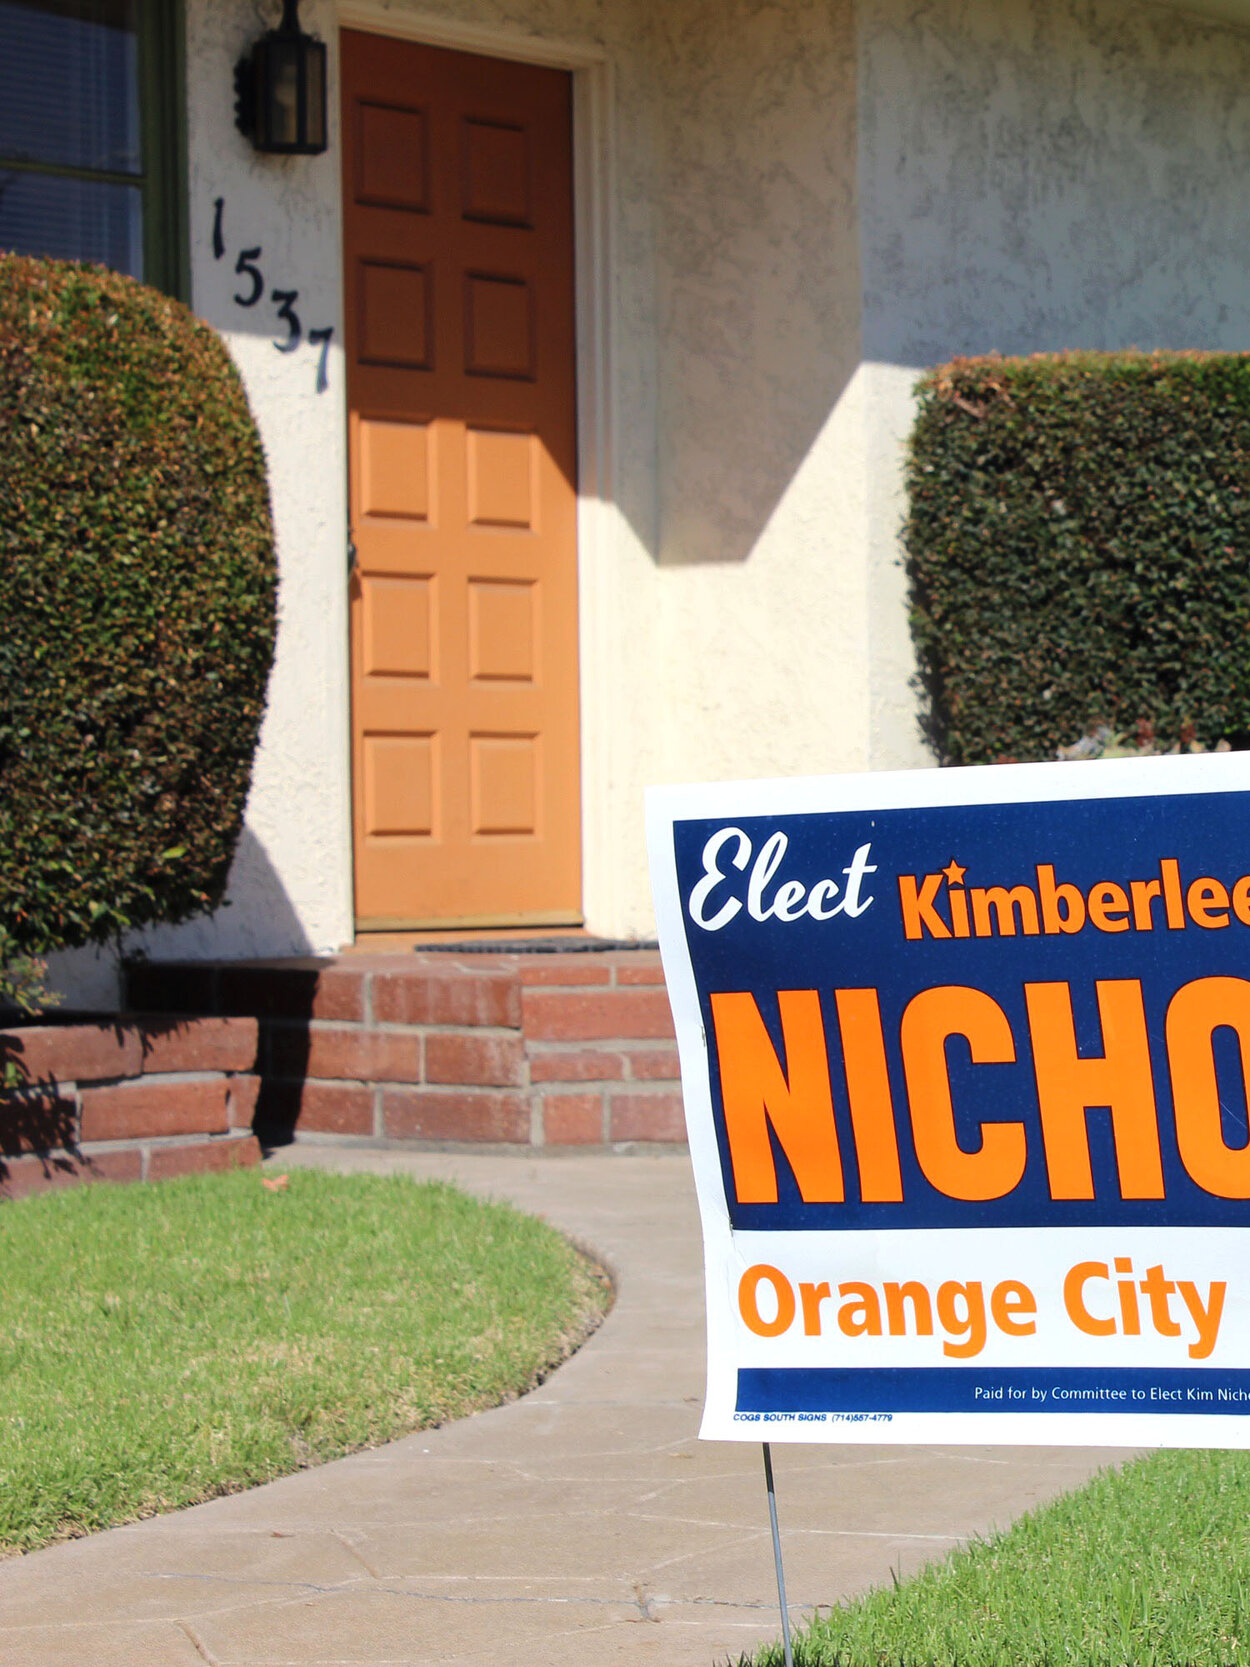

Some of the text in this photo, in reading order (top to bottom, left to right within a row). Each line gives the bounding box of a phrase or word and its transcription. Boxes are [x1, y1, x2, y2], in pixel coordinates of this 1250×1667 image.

[213, 197, 334, 394] 1537
[688, 827, 878, 931] Elect
[737, 1264, 1037, 1360] Orange
[1063, 1257, 1227, 1359] City
[733, 1413, 761, 1422] COGS
[763, 1413, 795, 1422] SOUTH
[797, 1413, 827, 1422] SIGNS
[975, 1387, 1002, 1400] Paid
[1008, 1387, 1026, 1400] for
[1031, 1387, 1047, 1402] by
[1051, 1387, 1127, 1400] Committee
[1131, 1388, 1146, 1400] to
[1150, 1388, 1182, 1400] Elect
[1187, 1388, 1213, 1401] Kim
